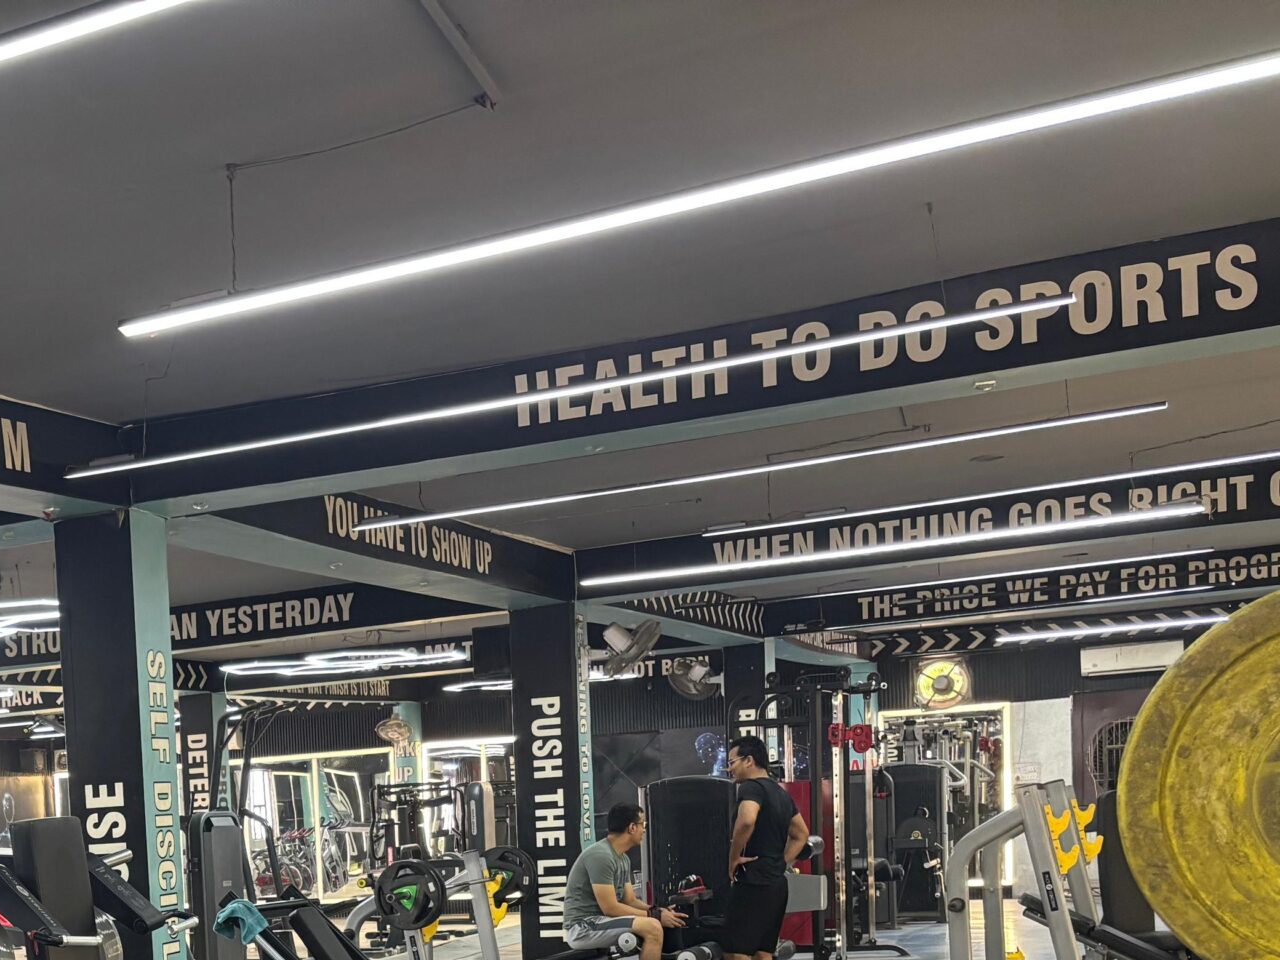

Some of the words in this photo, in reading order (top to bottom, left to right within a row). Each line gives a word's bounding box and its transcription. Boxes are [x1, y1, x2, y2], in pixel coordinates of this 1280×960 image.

[516, 338, 728, 427] HEALTH
[752, 322, 831, 387] TO
[858, 299, 946, 372] DO
[974, 243, 1258, 351] SPORTS
[324, 495, 360, 540] YOU
[365, 506, 404, 551] HAVE
[409, 521, 428, 558] TO
[432, 526, 472, 568] SHOW
[476, 538, 492, 574] UP
[714, 531, 814, 563] WHEN
[829, 507, 992, 552] NOTHING
[1009, 492, 1111, 530] GOES
[205, 593, 354, 637] YESTERDAY
[858, 594, 906, 619] THE
[917, 585, 995, 613] PRICE
[1006, 577, 1048, 604] WE
[1059, 570, 1111, 599] PAY
[1120, 563, 1176, 592] FOR
[145, 649, 171, 764] SELF
[325, 680, 348, 696] FINISH
[351, 680, 358, 696] IS
[360, 680, 368, 697] TO
[369, 680, 390, 697] START
[187, 733, 210, 813] DETER
[530, 695, 562, 779] PUSH
[84, 782, 131, 884] ISE
[534, 788, 566, 848] THE
[582, 782, 592, 842] LOVE
[537, 857, 568, 941] LIMIT
